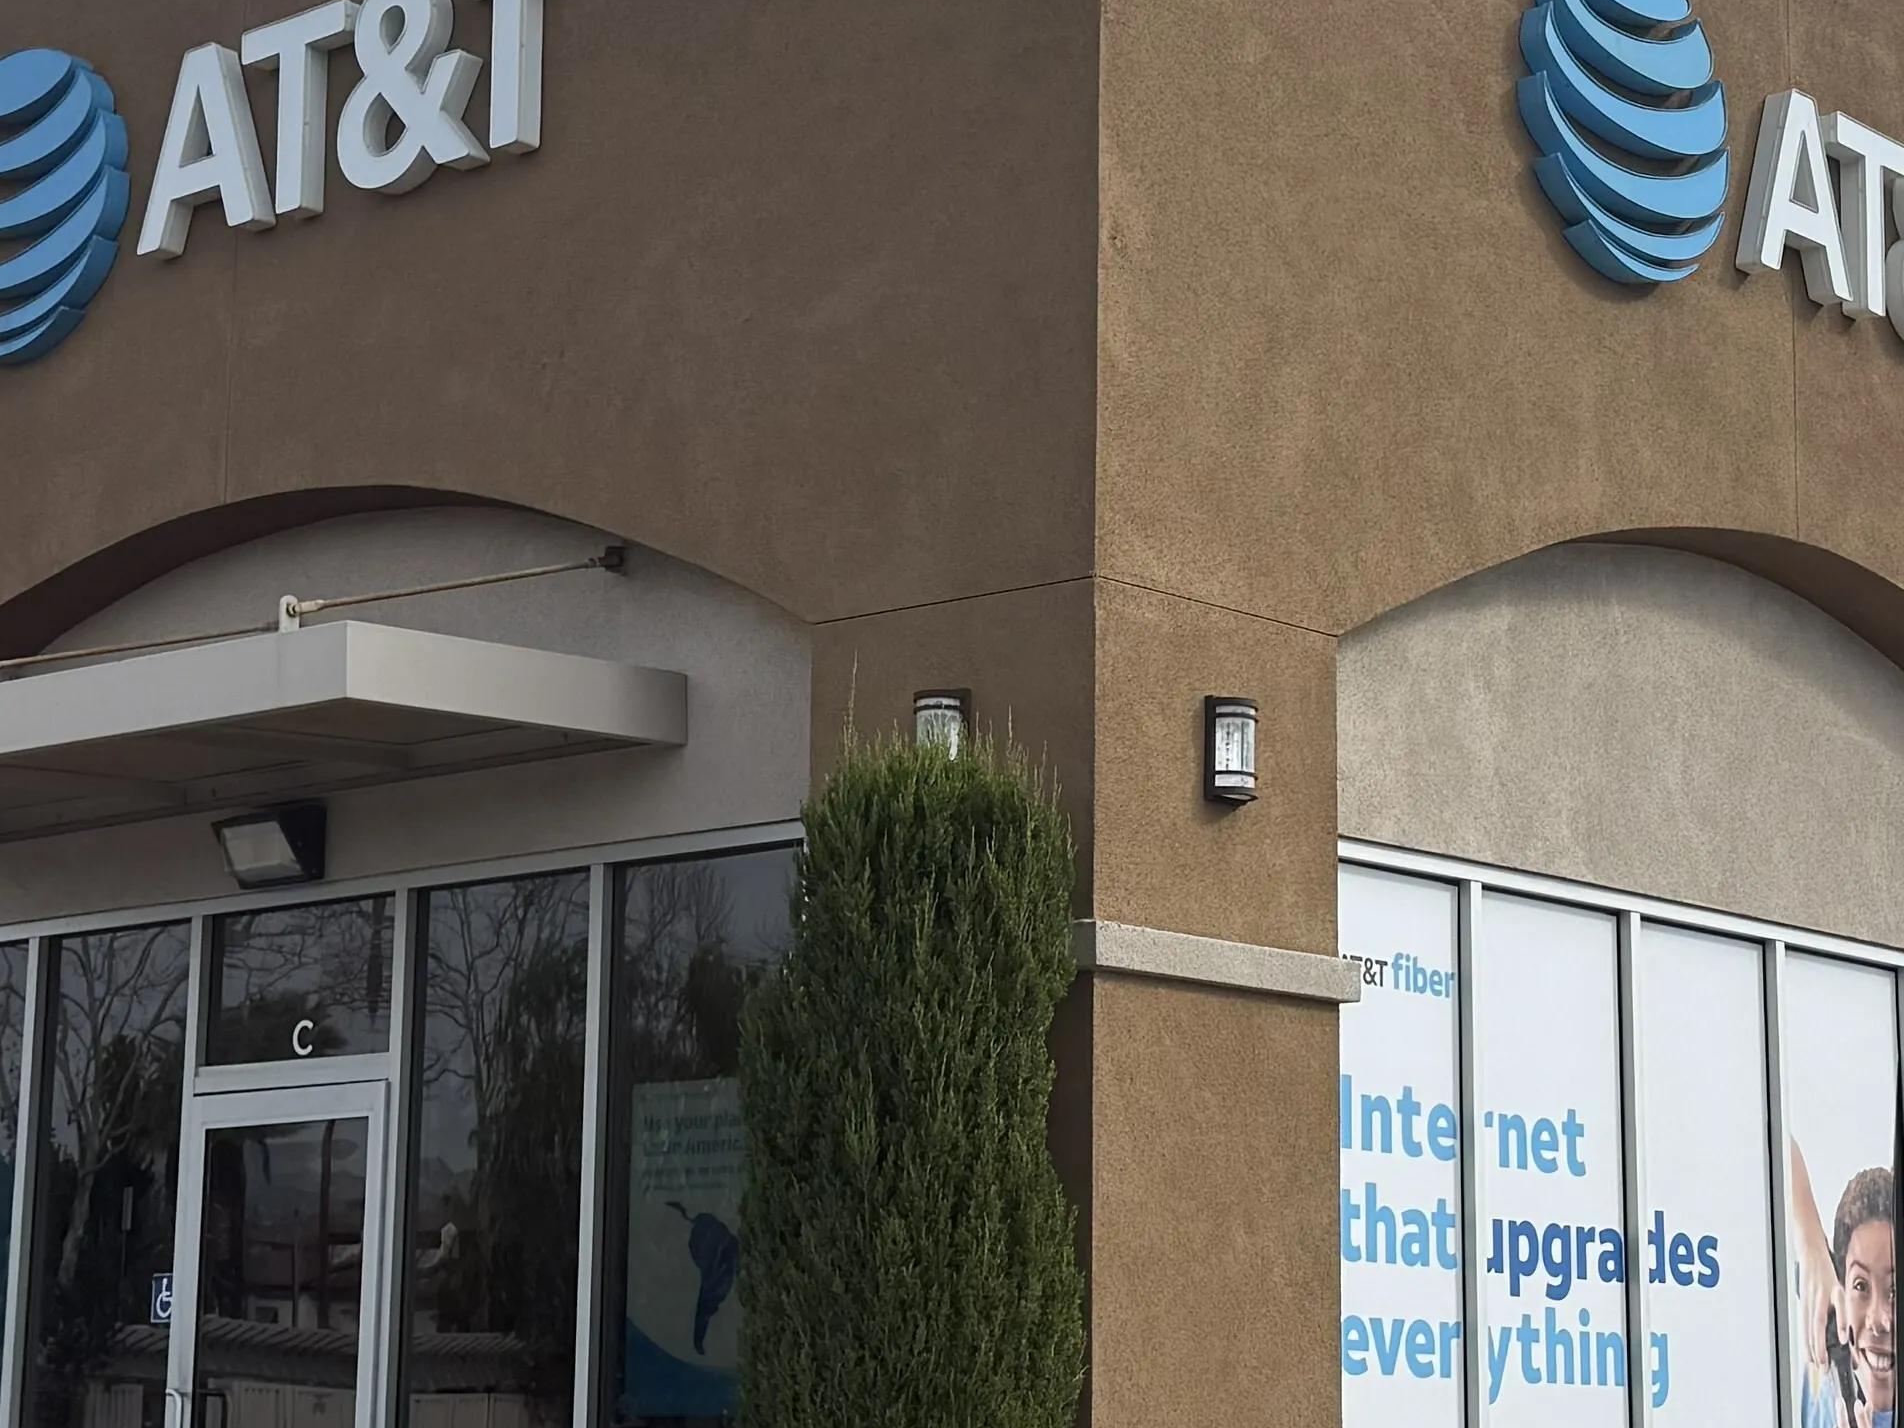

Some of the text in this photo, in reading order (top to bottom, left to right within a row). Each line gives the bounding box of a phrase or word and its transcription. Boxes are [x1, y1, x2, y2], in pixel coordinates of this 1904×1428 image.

[1342, 952, 1455, 998] &T fiber
[293, 1019, 314, 1056] C
[714, 1111, 746, 1133] pla
[1341, 1074, 1587, 1177] Intenet
[1340, 1182, 1459, 1271] that
[1342, 1306, 1670, 1409] everything
